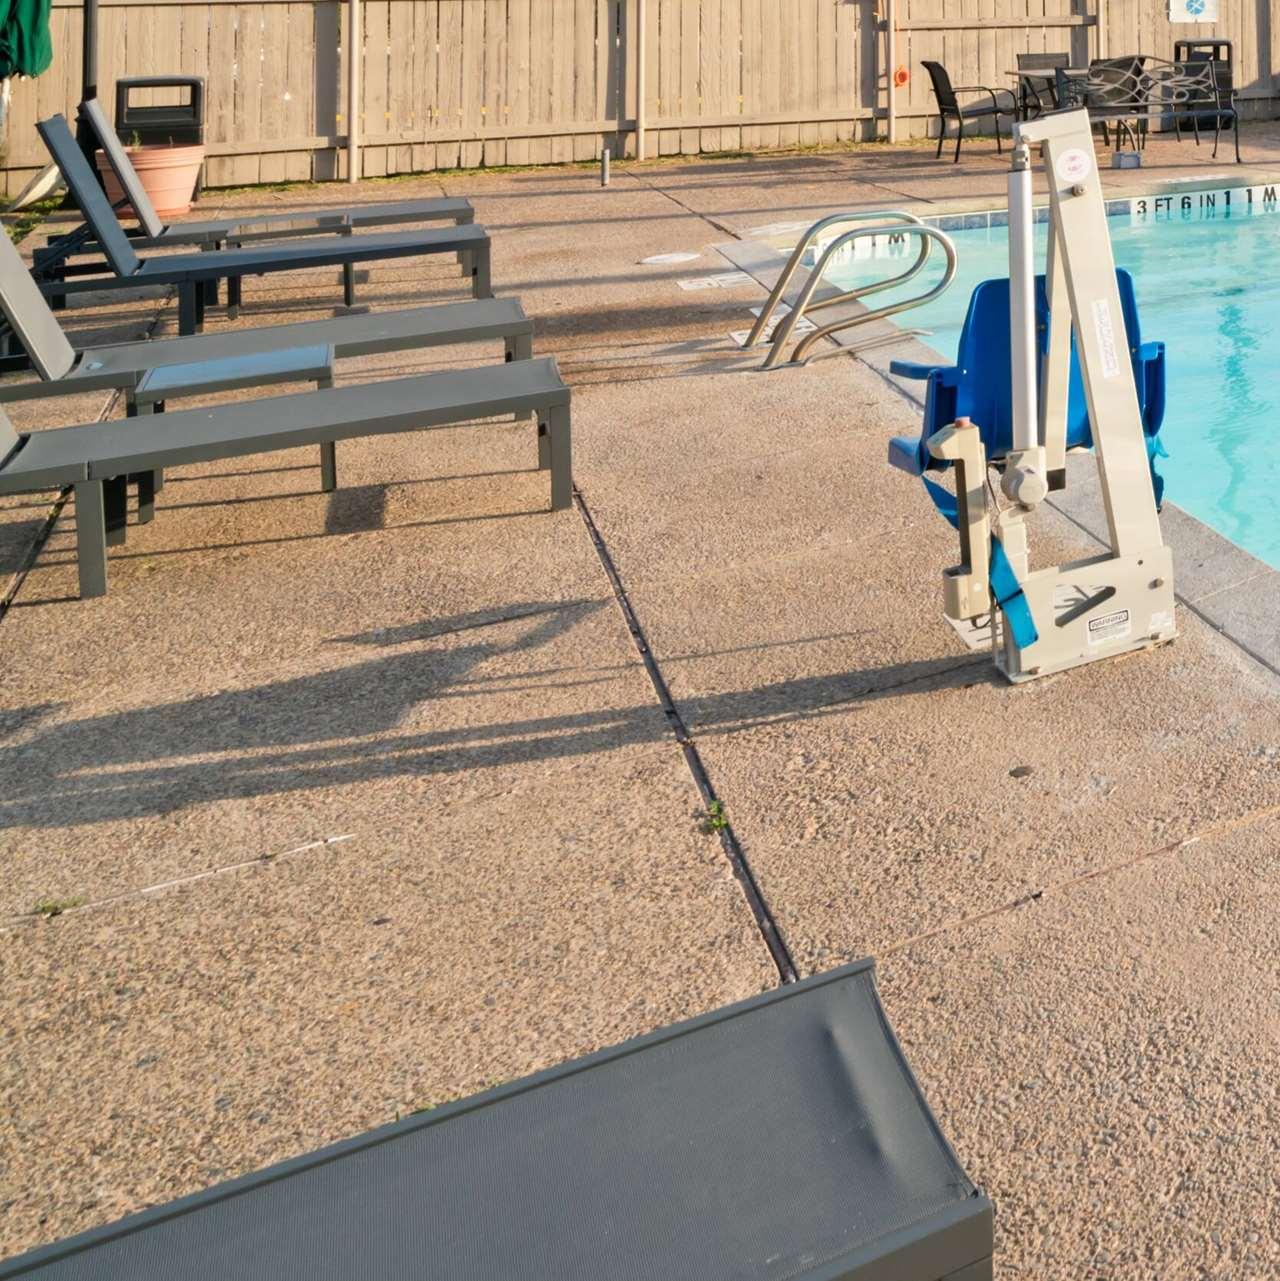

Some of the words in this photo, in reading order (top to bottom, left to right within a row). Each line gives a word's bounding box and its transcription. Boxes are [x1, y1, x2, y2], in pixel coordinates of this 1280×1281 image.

[1137, 200, 1147, 213] 3
[1154, 197, 1173, 212] FT
[1181, 196, 1191, 209] 6
[1199, 194, 1216, 208] IN
